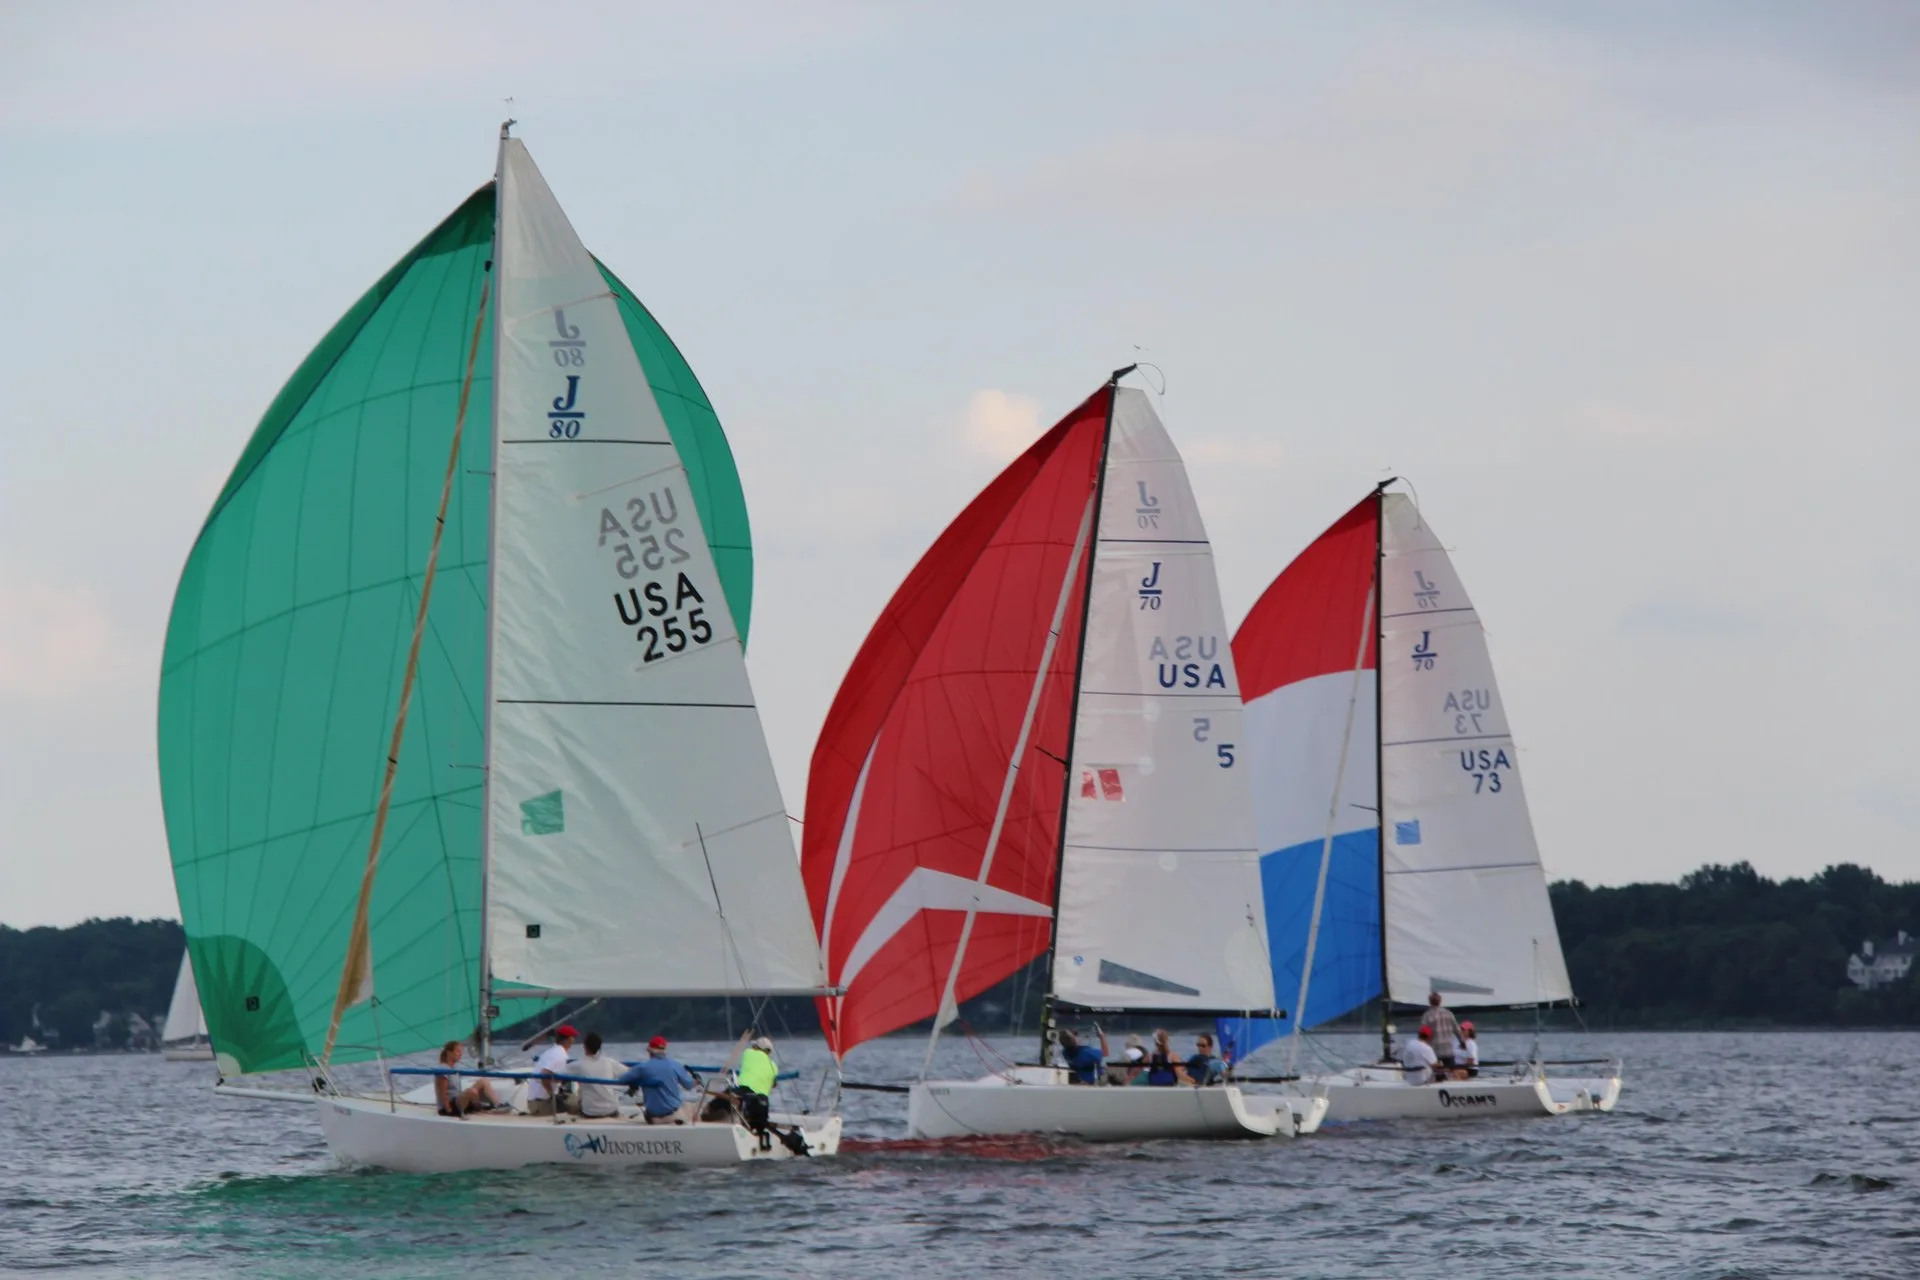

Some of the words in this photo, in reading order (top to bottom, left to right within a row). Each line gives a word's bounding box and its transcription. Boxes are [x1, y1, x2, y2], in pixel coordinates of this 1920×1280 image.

[552, 375, 581, 411] J
[548, 419, 580, 439] 80
[1141, 562, 1162, 588] J
[613, 571, 705, 627] USA
[1139, 596, 1161, 611] 70
[636, 607, 713, 663] 255
[1413, 631, 1431, 653] J
[1158, 663, 1226, 689] USA
[1413, 657, 1435, 672] 70
[1216, 743, 1235, 769] 5
[1459, 748, 1512, 772] USA
[1471, 772, 1502, 795] 73
